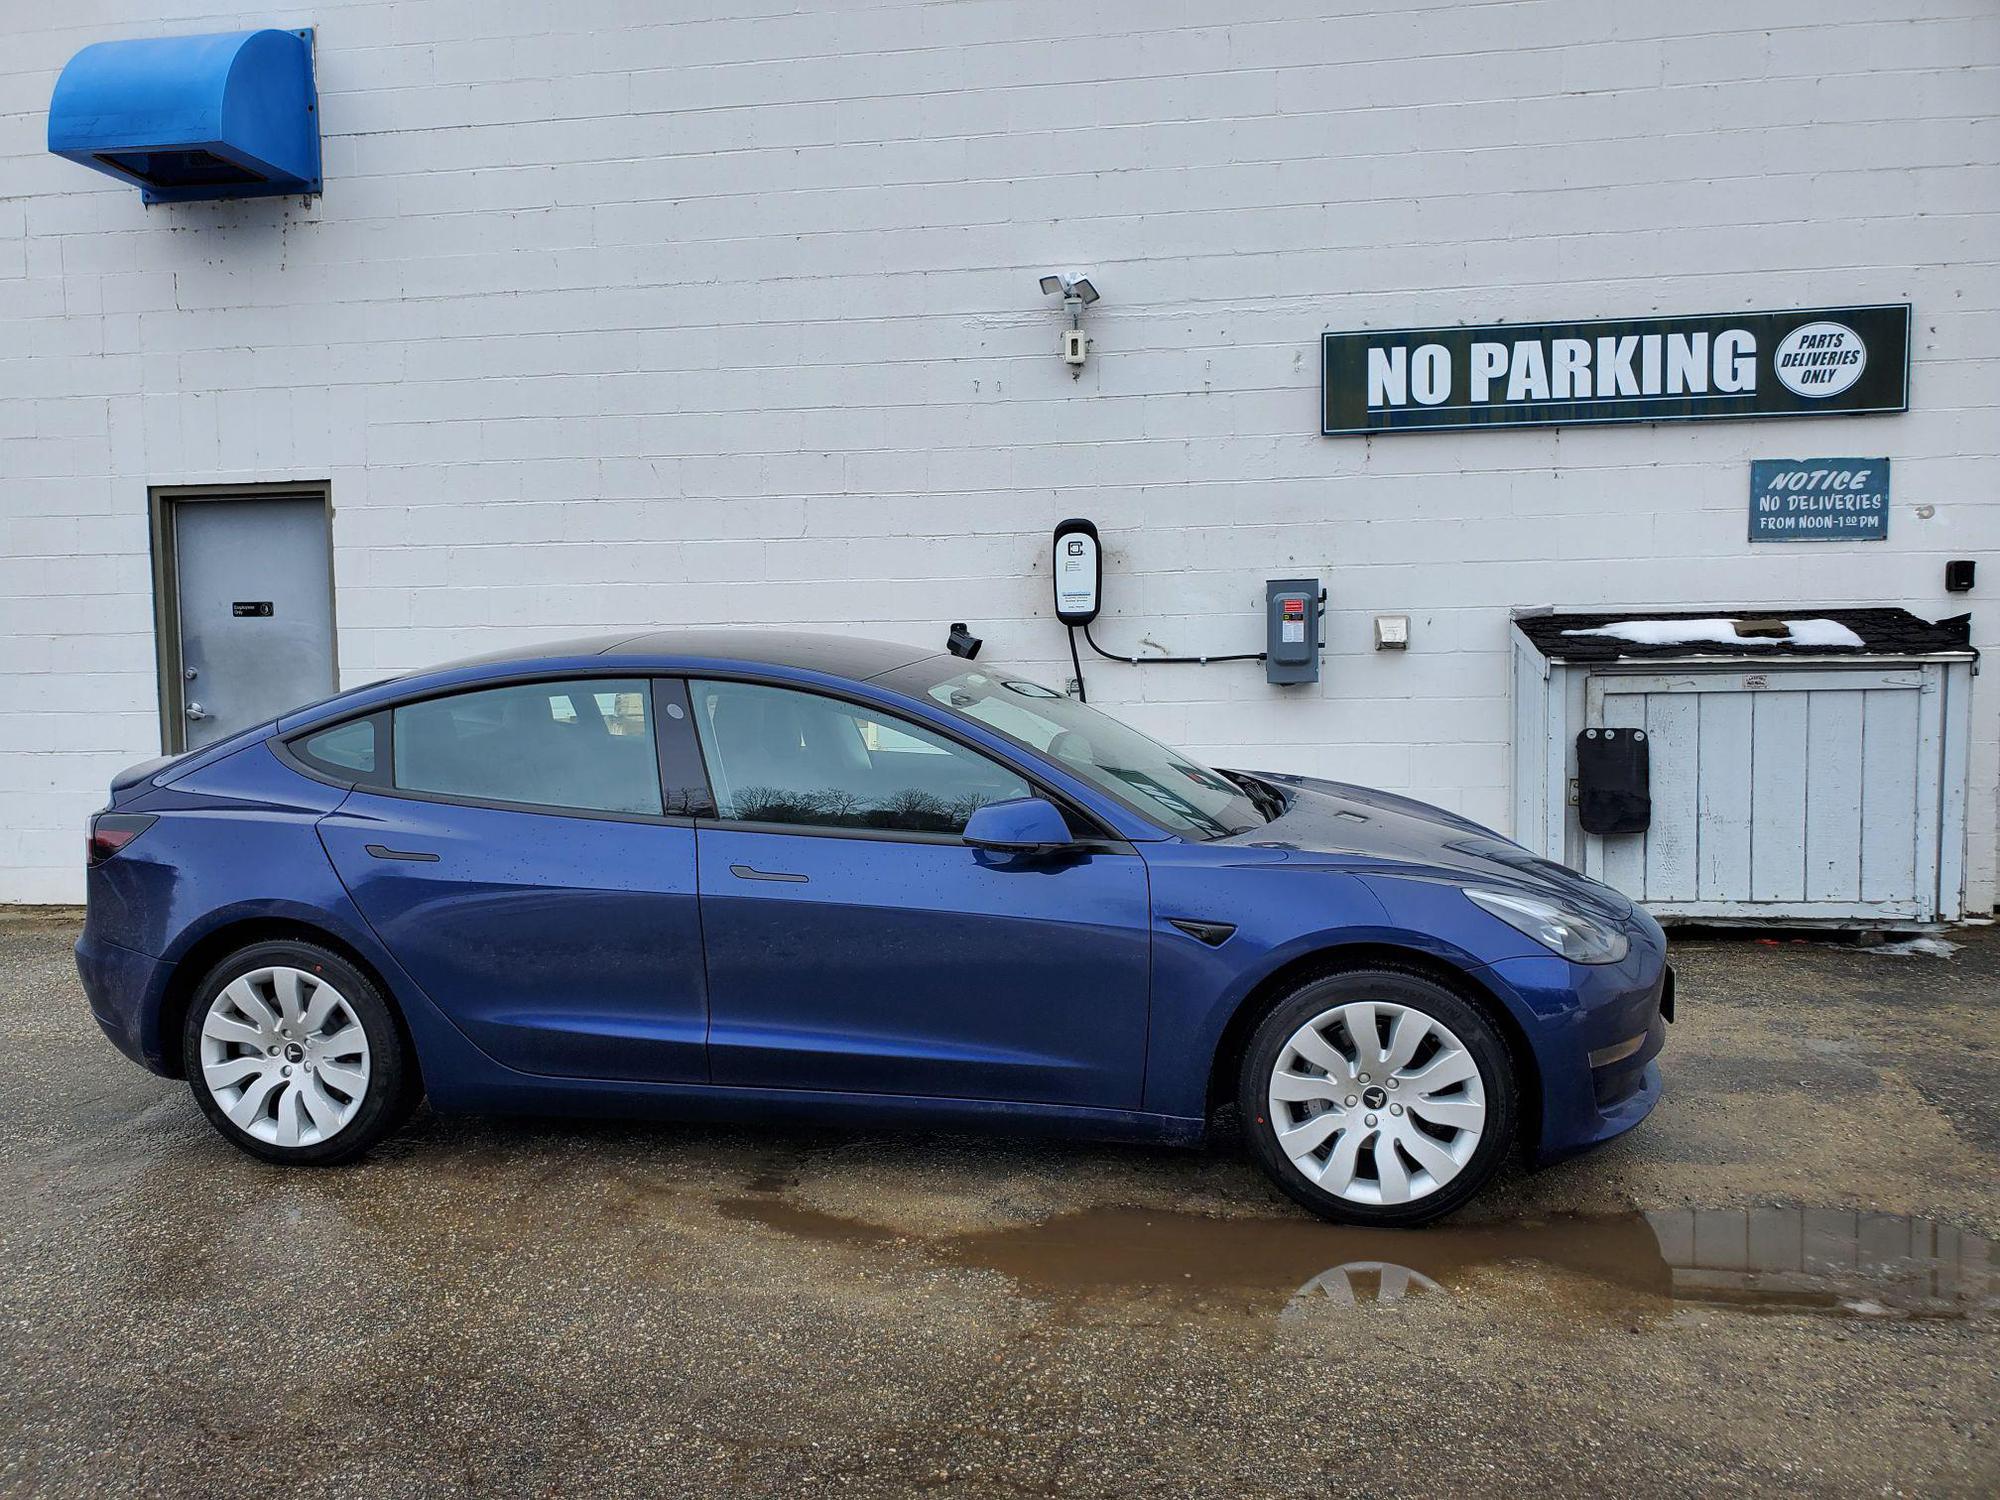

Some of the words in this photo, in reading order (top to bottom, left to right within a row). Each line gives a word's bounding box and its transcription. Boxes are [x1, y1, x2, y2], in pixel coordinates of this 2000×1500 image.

[1798, 333, 1845, 350] PARTS
[1780, 350, 1860, 368] DELIVERIES
[1367, 343, 1452, 407] NO
[1470, 329, 1757, 402] PARKING
[1800, 369, 1838, 384] ONLY
[1767, 470, 1872, 491] NOTICE
[1760, 495, 1780, 511] NO
[1787, 494, 1881, 511] DELIVERIES
[1760, 517, 1795, 529] FROM
[1860, 516, 1879, 528] PM
